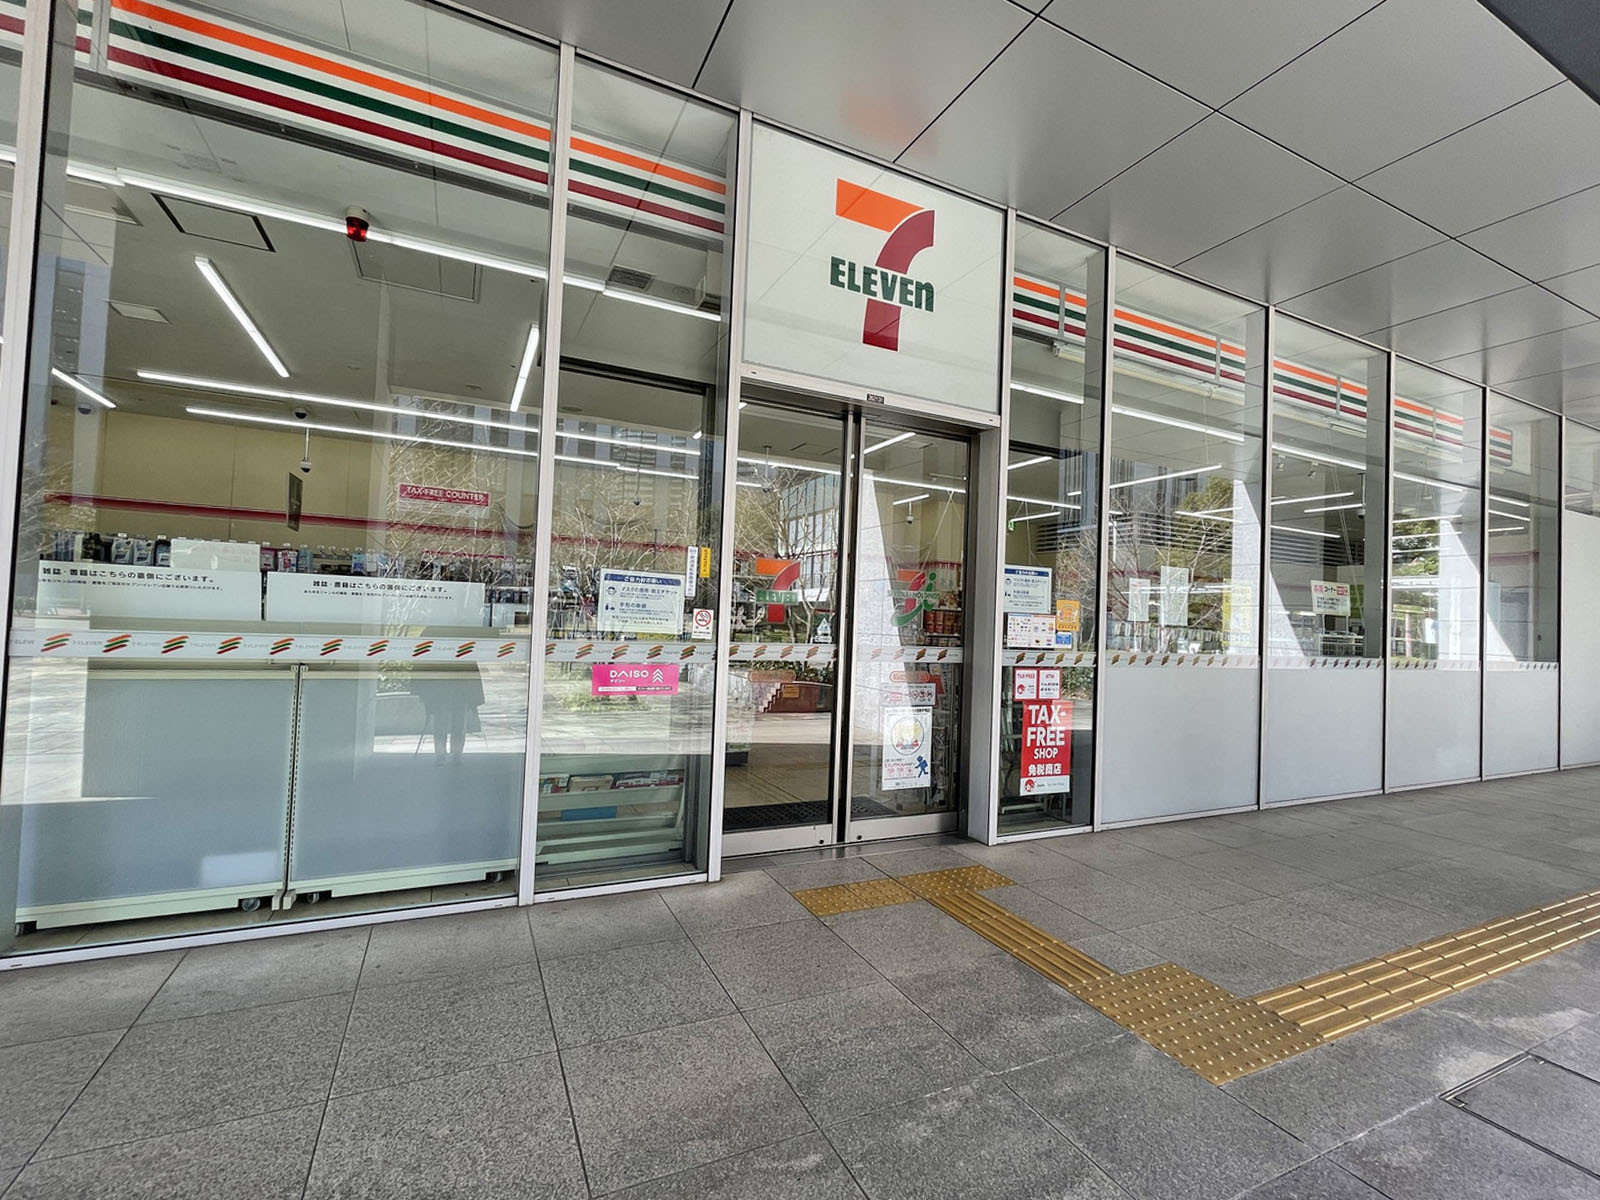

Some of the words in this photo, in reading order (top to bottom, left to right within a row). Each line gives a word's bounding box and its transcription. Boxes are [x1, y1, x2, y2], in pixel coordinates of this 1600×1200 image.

[835, 178, 935, 352] 7
[445, 490, 485, 502] COUNTER
[609, 669, 650, 679] DAISO
[1028, 704, 1067, 725] TAX-
[1026, 726, 1066, 747] FREE
[1033, 747, 1059, 760] SHOP
